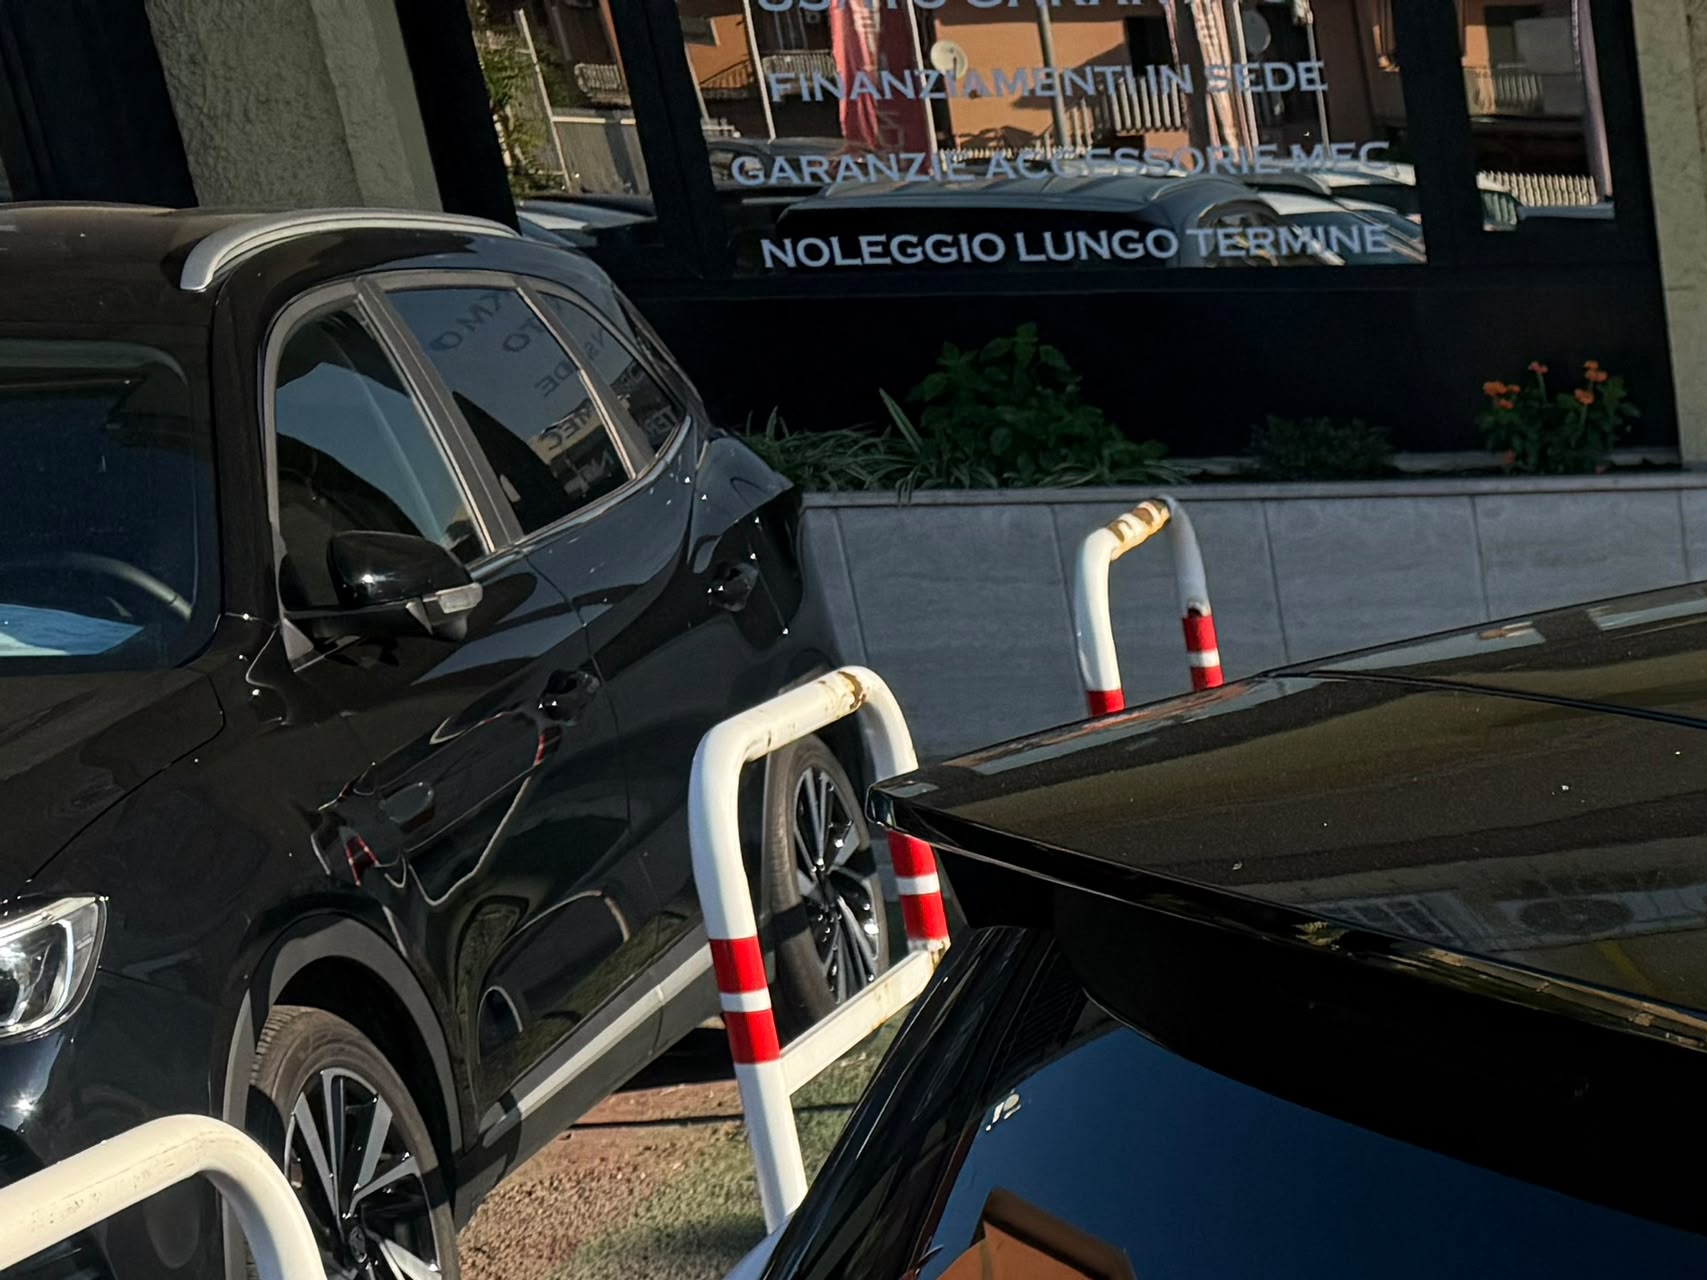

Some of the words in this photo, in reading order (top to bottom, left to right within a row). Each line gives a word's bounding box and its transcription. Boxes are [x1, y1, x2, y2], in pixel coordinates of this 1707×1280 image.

[768, 64, 1137, 102] FINANZIAMENTI
[1146, 64, 1194, 95] IN
[1204, 60, 1328, 93] SEDE
[731, 152, 976, 186] GARANZIE
[985, 143, 1280, 179] ACCESSORIE
[1290, 140, 1390, 175] MEC
[760, 232, 1006, 268] NOLEGGIO
[1015, 228, 1179, 262] LUNGO
[1186, 223, 1389, 258] TERMINE
